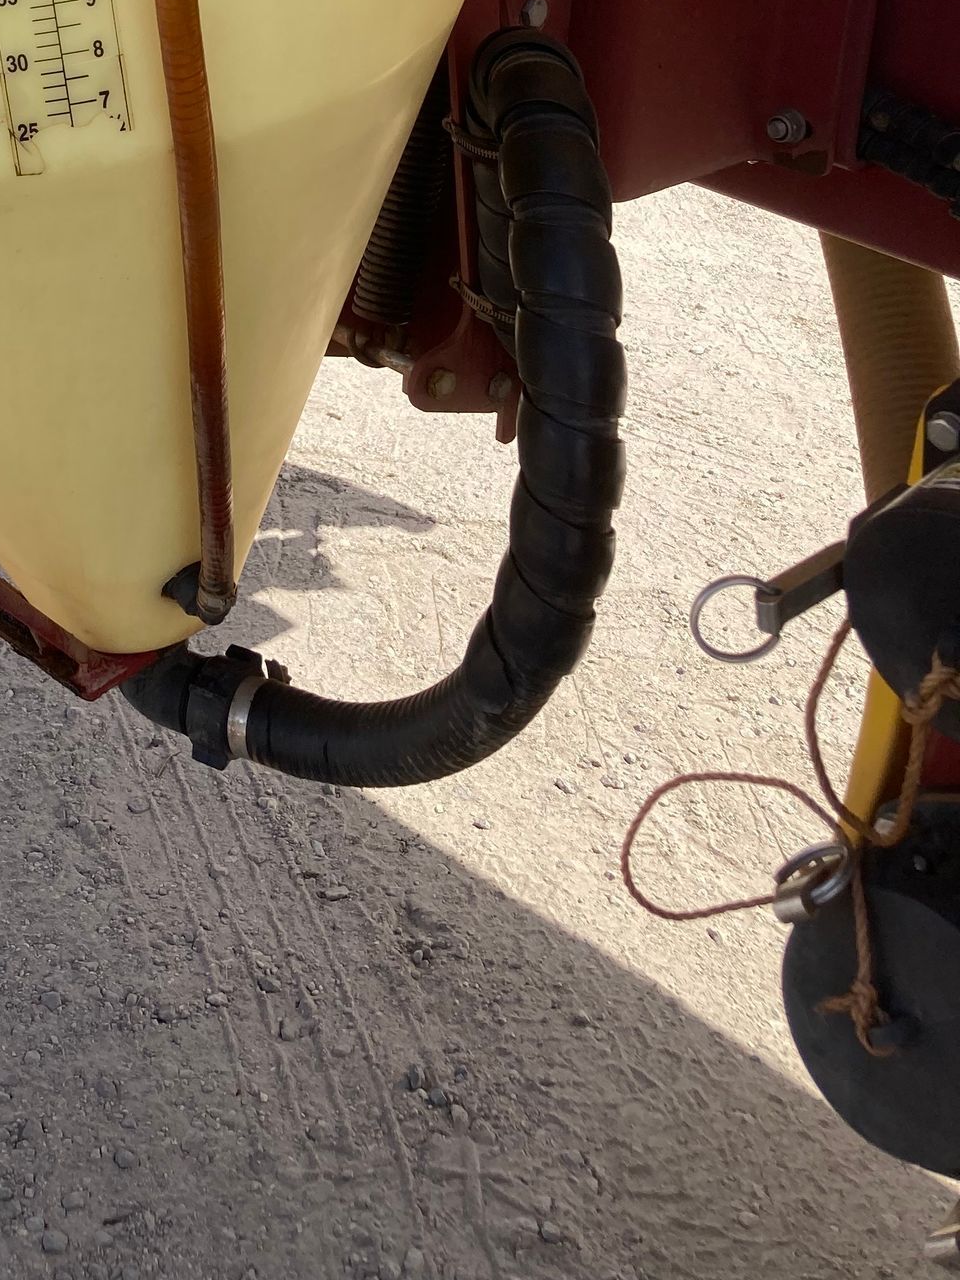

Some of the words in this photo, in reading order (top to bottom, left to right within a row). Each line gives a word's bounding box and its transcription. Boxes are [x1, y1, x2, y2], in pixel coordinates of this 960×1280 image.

[93, 40, 104, 57] 8
[7, 54, 28, 72] 30
[99, 90, 109, 108] 7
[17, 123, 38, 141] 25
